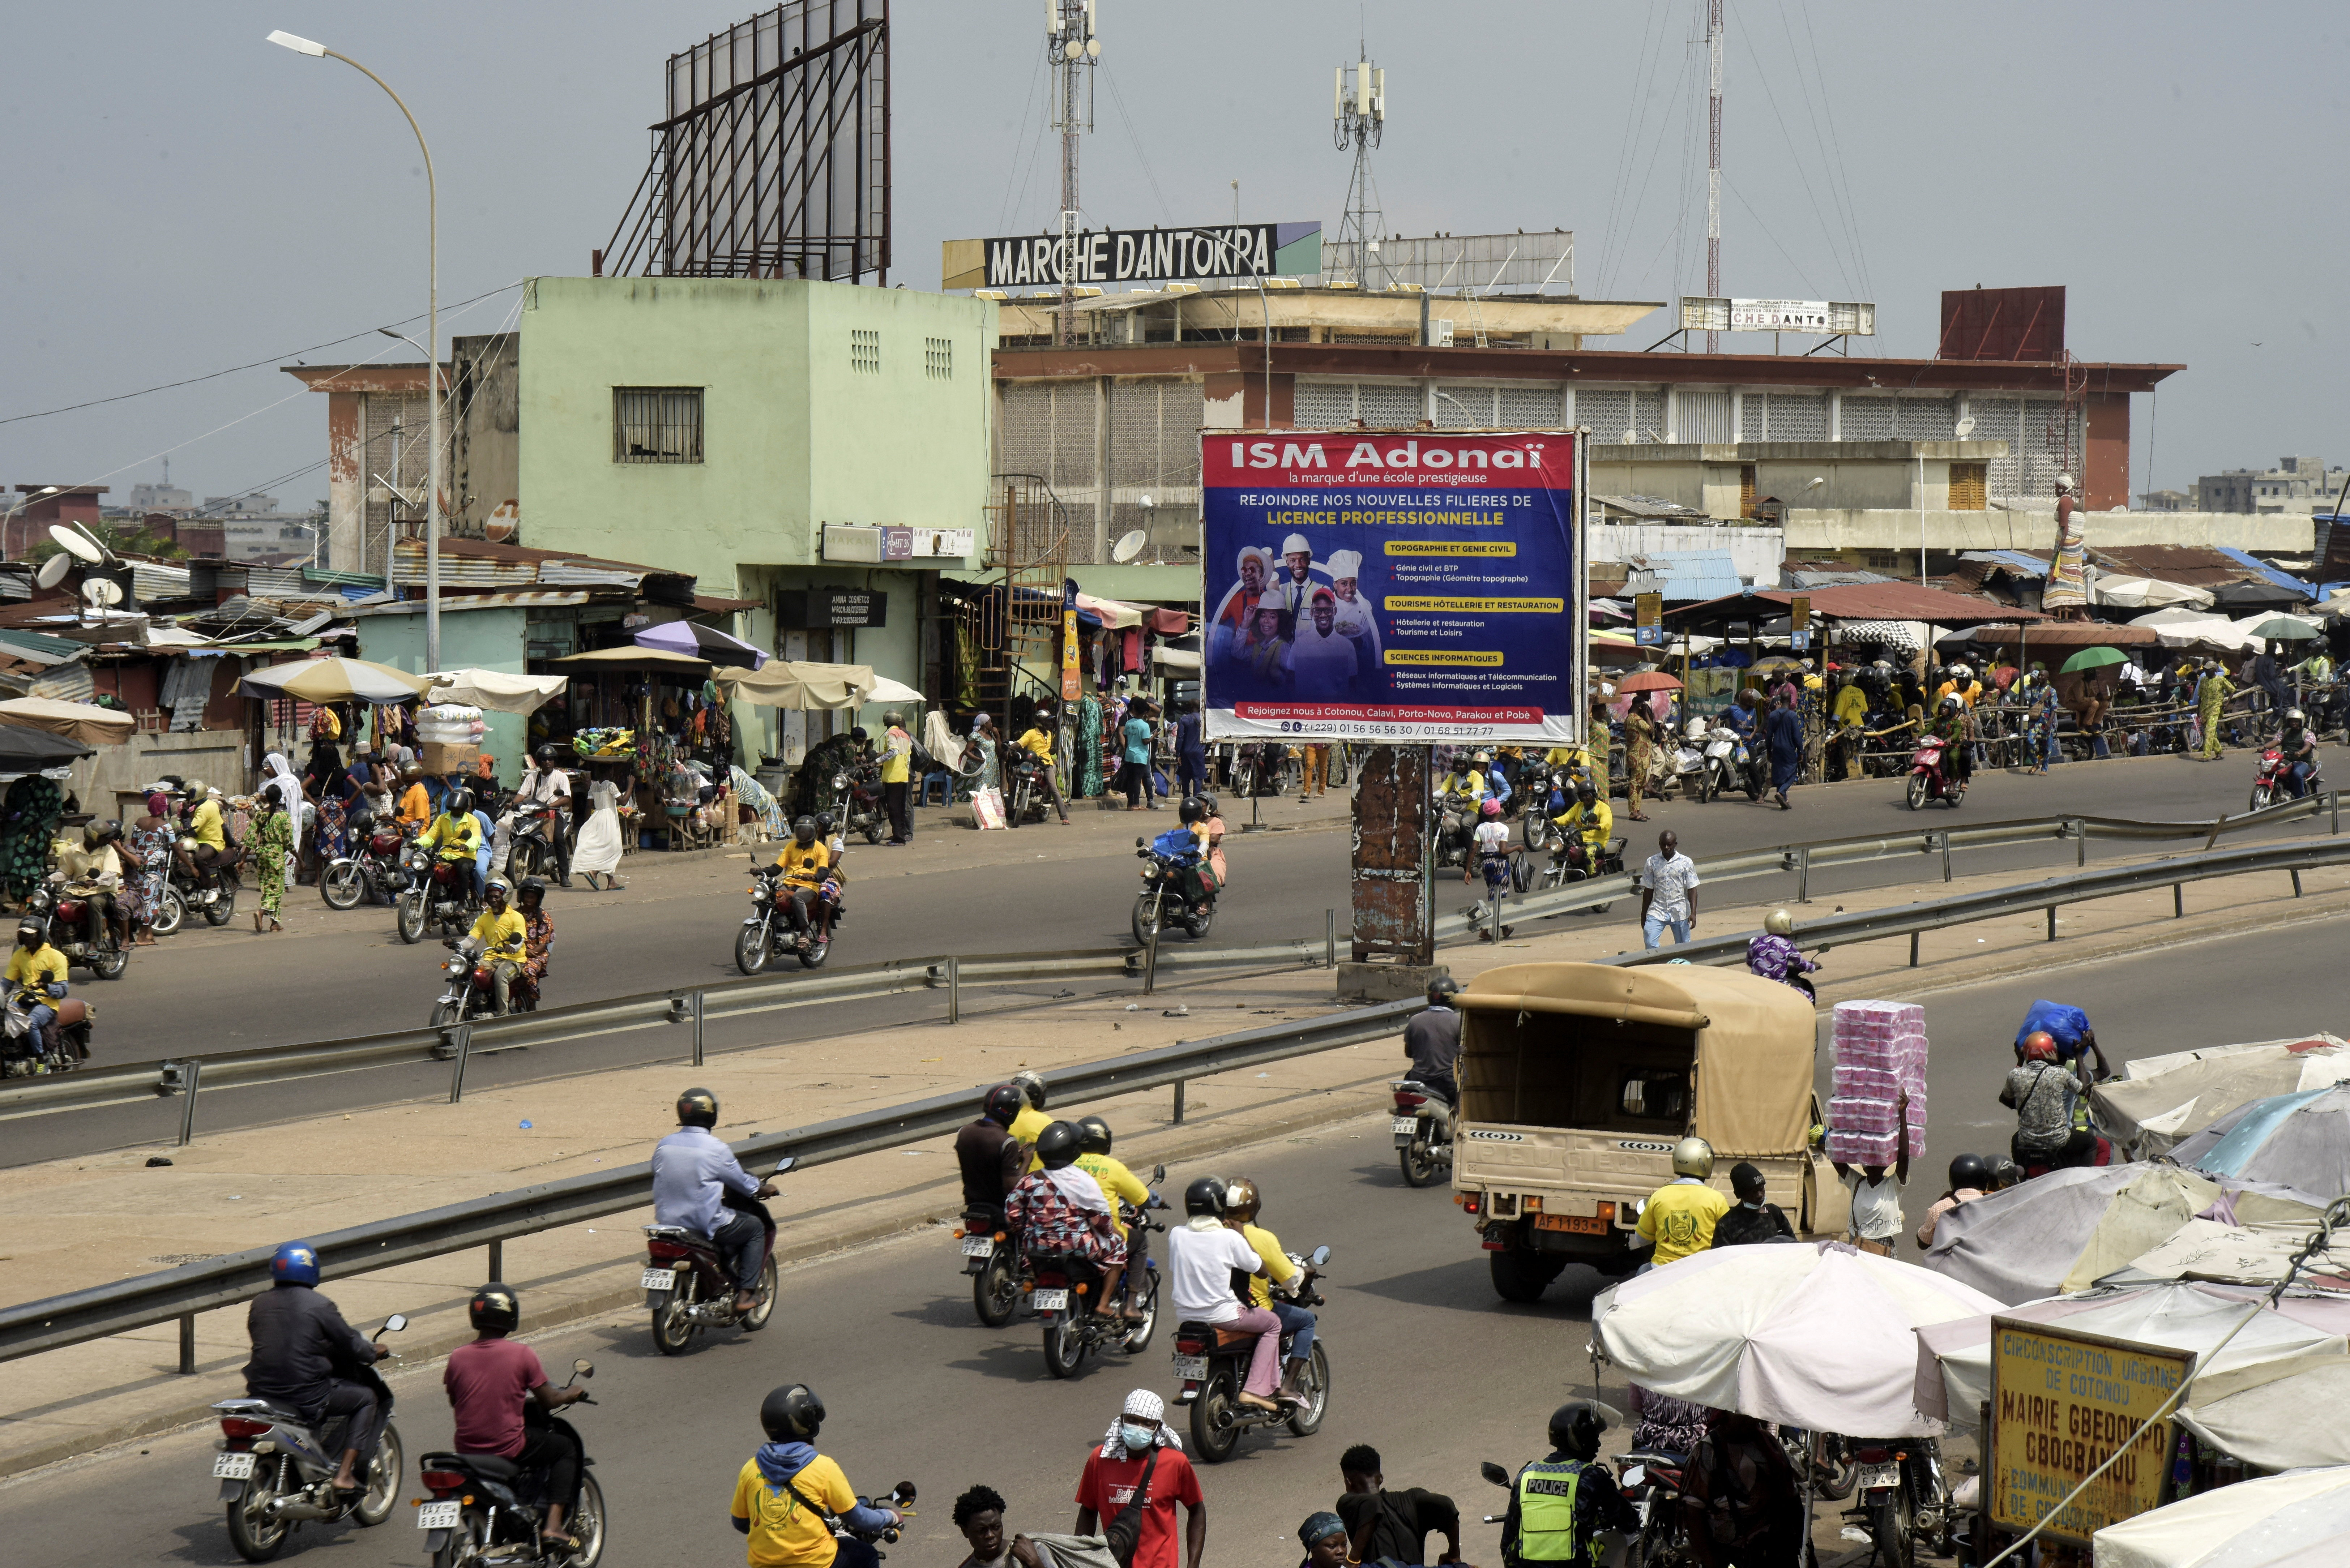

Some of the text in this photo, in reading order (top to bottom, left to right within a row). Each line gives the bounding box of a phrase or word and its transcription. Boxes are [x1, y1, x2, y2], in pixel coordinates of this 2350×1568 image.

[991, 228, 1269, 285] MARCHE DANTOKPA
[1734, 313, 1765, 324] CHE
[1231, 440, 1545, 469] ISM Adonaï
[1289, 472, 1487, 487] la marque d'une école prestigieuse
[1240, 495, 1531, 506] REJOINDRE NOS NOUVELLES FILIERES DE
[1267, 511, 1504, 525] LICENCE PROFESSIONNELLE
[1443, 574, 1481, 582] (Géomètre
[832, 595, 870, 604] AMINA COSMETICS
[1433, 599, 1483, 609] HÔTELLERIE
[1248, 706, 1291, 716] Rejoignez
[1324, 707, 1364, 717] Cotonou,
[1367, 708, 1396, 719] Calavi,
[1398, 710, 1453, 720] Porto-Novo,
[1506, 711, 1530, 720] Pobè
[1304, 723, 1337, 733] (+229)
[1340, 724, 1350, 733] 01
[1353, 724, 1365, 733] 56
[1369, 725, 1381, 734] 56
[1384, 725, 1396, 734] 56
[1400, 725, 1413, 734] 30
[1424, 726, 1435, 735] 01
[1438, 726, 1450, 735] 68
[1453, 727, 1463, 735] 51
[1466, 727, 1478, 736] 77
[1481, 727, 1494, 736] 77
[1477, 1143, 1665, 1175] PEUGEOT
[1539, 1216, 1554, 1228] AF
[1558, 1217, 1588, 1231] 1193
[964, 1246, 990, 1255] 2707
[2003, 1334, 2178, 1392] CIRCONSCRIPTION URBAINE
[1176, 1368, 1204, 1379] 2448
[2045, 1367, 2130, 1406] DE COTONOU
[2002, 1389, 2165, 1455] MAIRIE GBEDOKPO
[2025, 1431, 2136, 1485] GBOGBANOU
[1859, 1465, 1880, 1475] 2CX
[1528, 1479, 1568, 1496] POLICE
[1862, 1475, 1896, 1486] 6342
[2011, 1468, 2076, 1500] COMMUNE
[2010, 1493, 2027, 1517] DE
